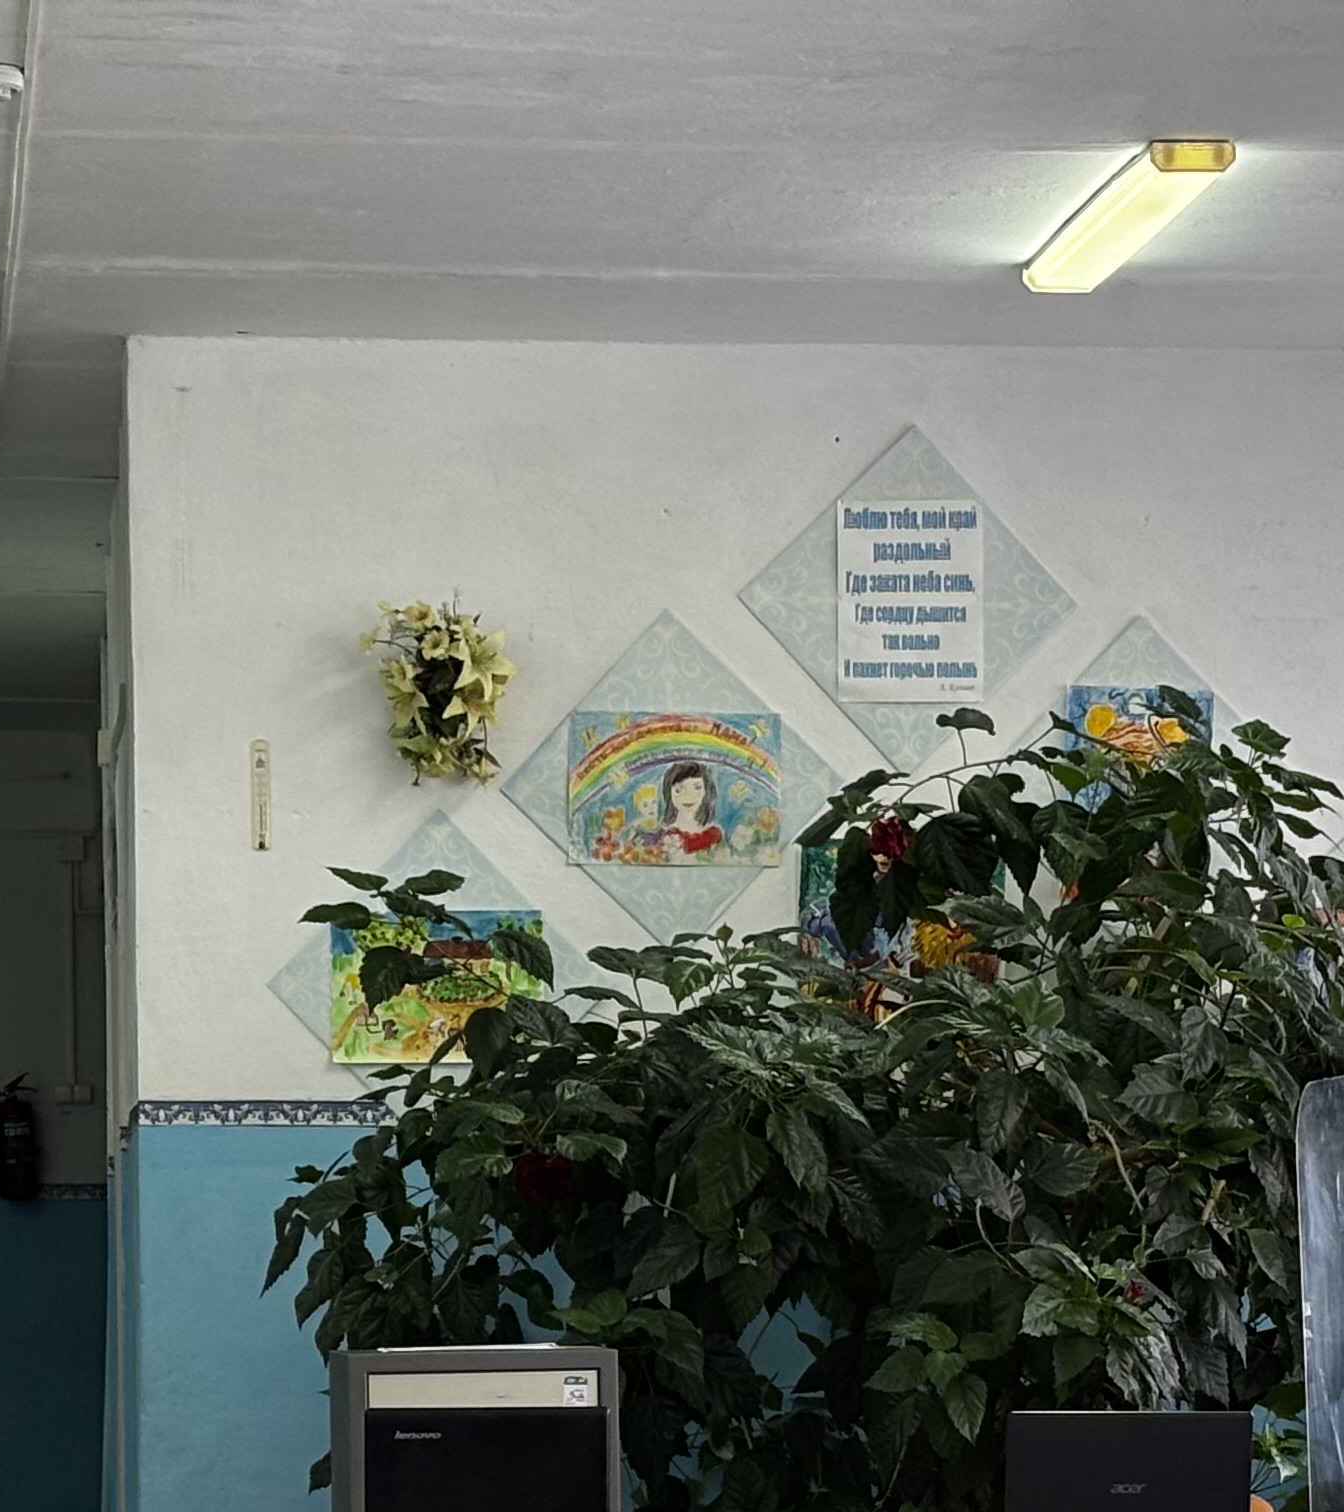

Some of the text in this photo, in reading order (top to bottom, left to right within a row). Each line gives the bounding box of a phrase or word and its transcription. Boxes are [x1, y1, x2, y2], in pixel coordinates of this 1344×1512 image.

[844, 506, 977, 531] Люблю тебя, мой край
[873, 538, 951, 564] раздольный
[846, 571, 868, 596] Где
[869, 573, 911, 593] заката
[913, 571, 941, 593] неба
[855, 603, 874, 624] Где
[882, 634, 900, 650] так
[394, 1430, 442, 1440] lenovo
[1110, 1483, 1147, 1494] acer
